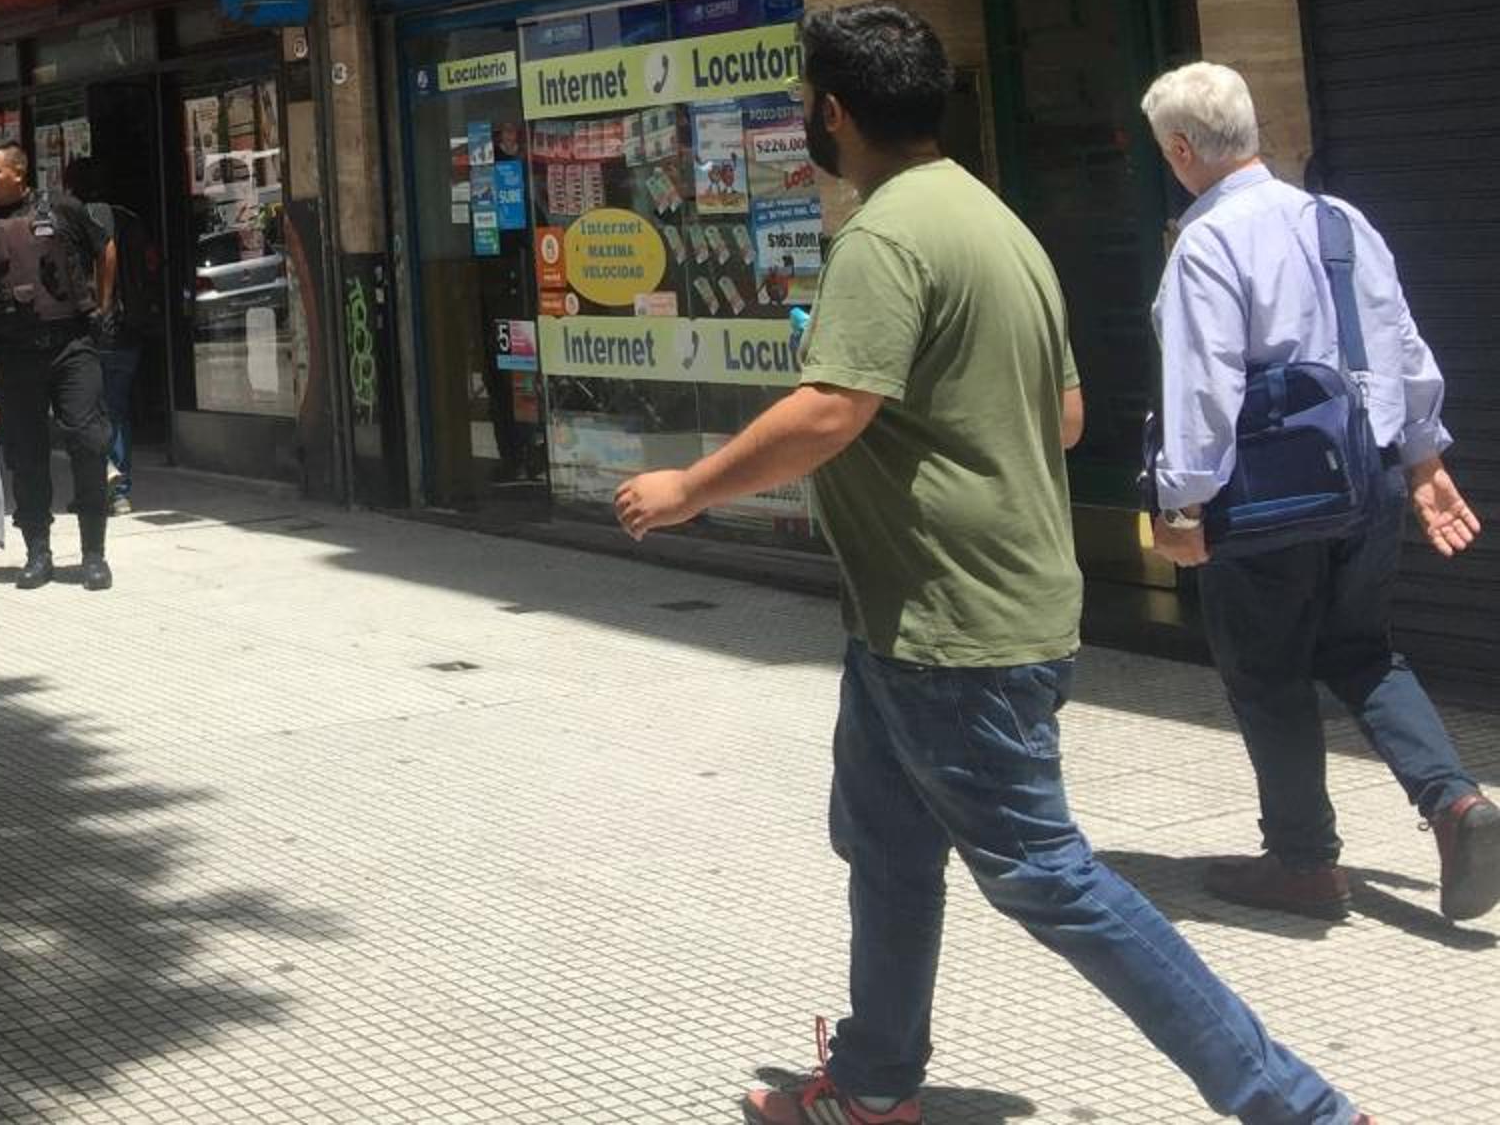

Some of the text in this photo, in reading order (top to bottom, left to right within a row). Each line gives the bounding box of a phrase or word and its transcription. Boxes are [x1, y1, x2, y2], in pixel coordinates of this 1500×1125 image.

[446, 60, 508, 84] Locutorio
[538, 40, 804, 107] Internet Locutori
[580, 218, 642, 235] Internet
[562, 327, 656, 369] Internet
[723, 328, 803, 373] Locut
